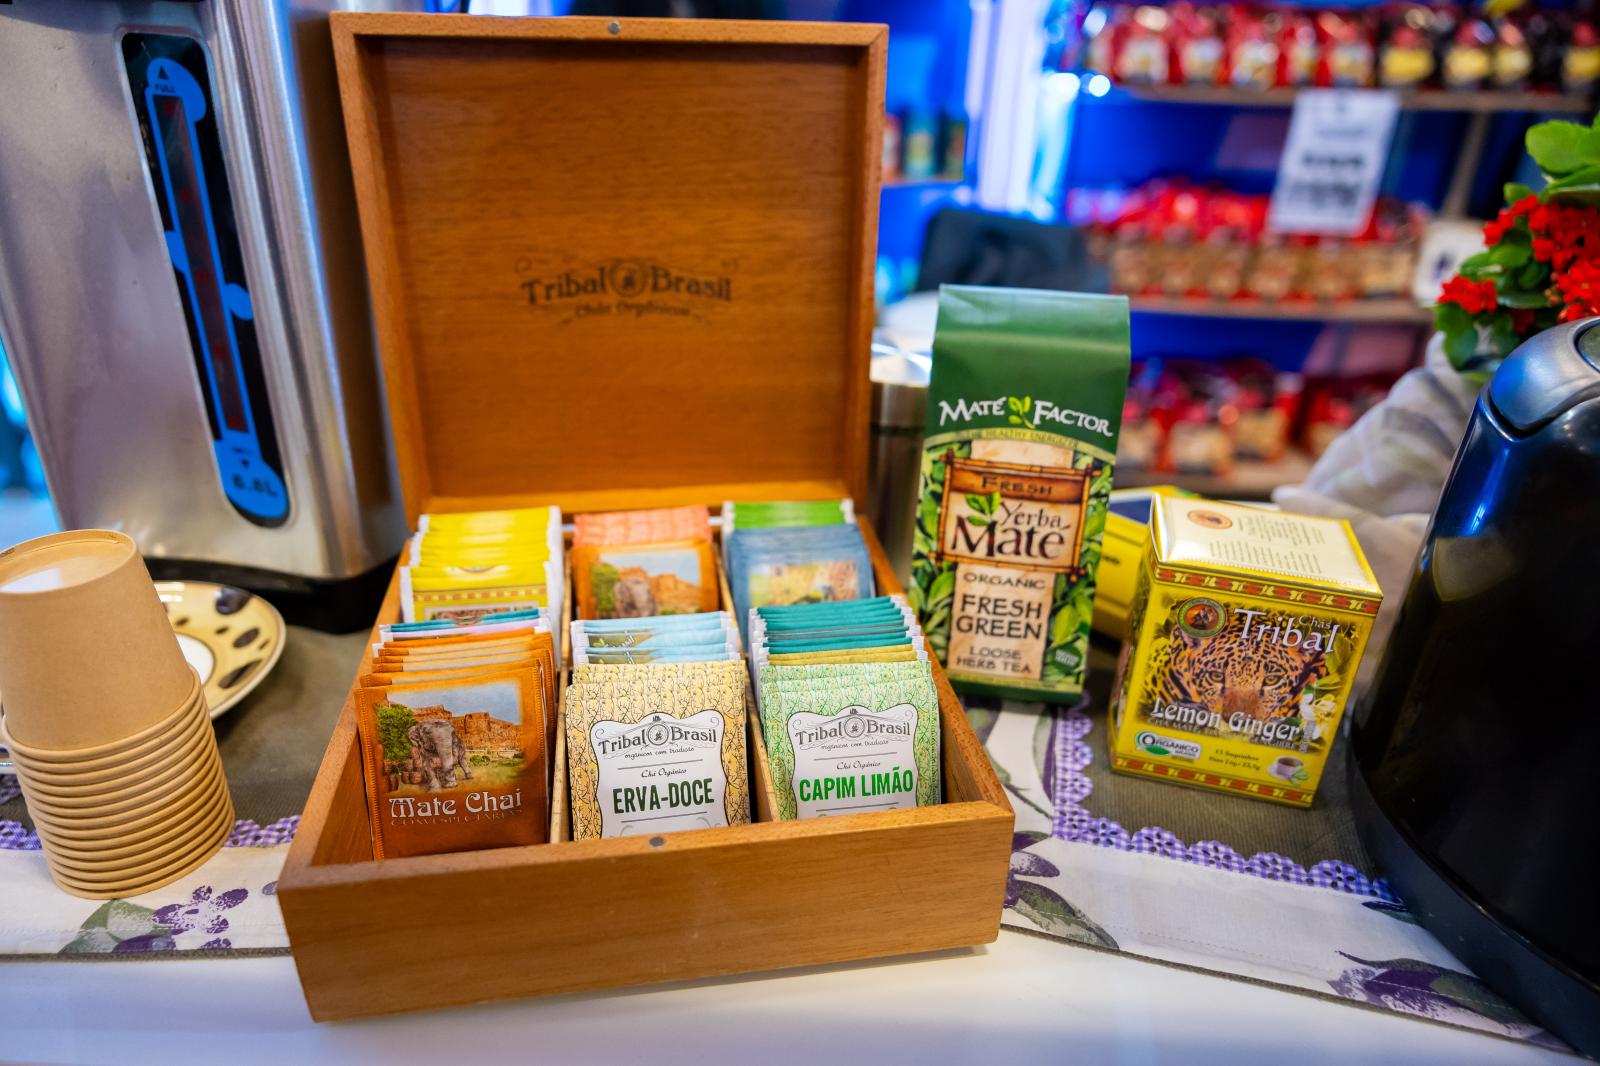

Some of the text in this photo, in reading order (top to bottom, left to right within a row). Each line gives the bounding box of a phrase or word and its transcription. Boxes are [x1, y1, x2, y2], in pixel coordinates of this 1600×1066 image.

[519, 264, 733, 306] Tribal Brasil
[980, 476, 1053, 496] FRESH
[999, 501, 1062, 527] Yerba
[963, 571, 1047, 590] ORGANIC
[960, 593, 1043, 619] FRESH
[956, 615, 1043, 640] GREEN
[1233, 608, 1340, 654] Tribal
[956, 656, 1032, 674] HERB TEA
[968, 645, 1022, 661] LOOSE
[795, 718, 911, 745] Tribal Brasil
[1151, 697, 1221, 728] Lemon
[1228, 711, 1300, 741] Ginger
[597, 725, 717, 755] Tribal Brasil
[641, 767, 687, 778] Chá Orgânico
[836, 759, 881, 770] Chá Orgânico
[612, 777, 715, 814] ERVA-DOCE
[799, 766, 914, 802] CAPIM LIMÃO
[388, 787, 522, 818] Mate Chai
